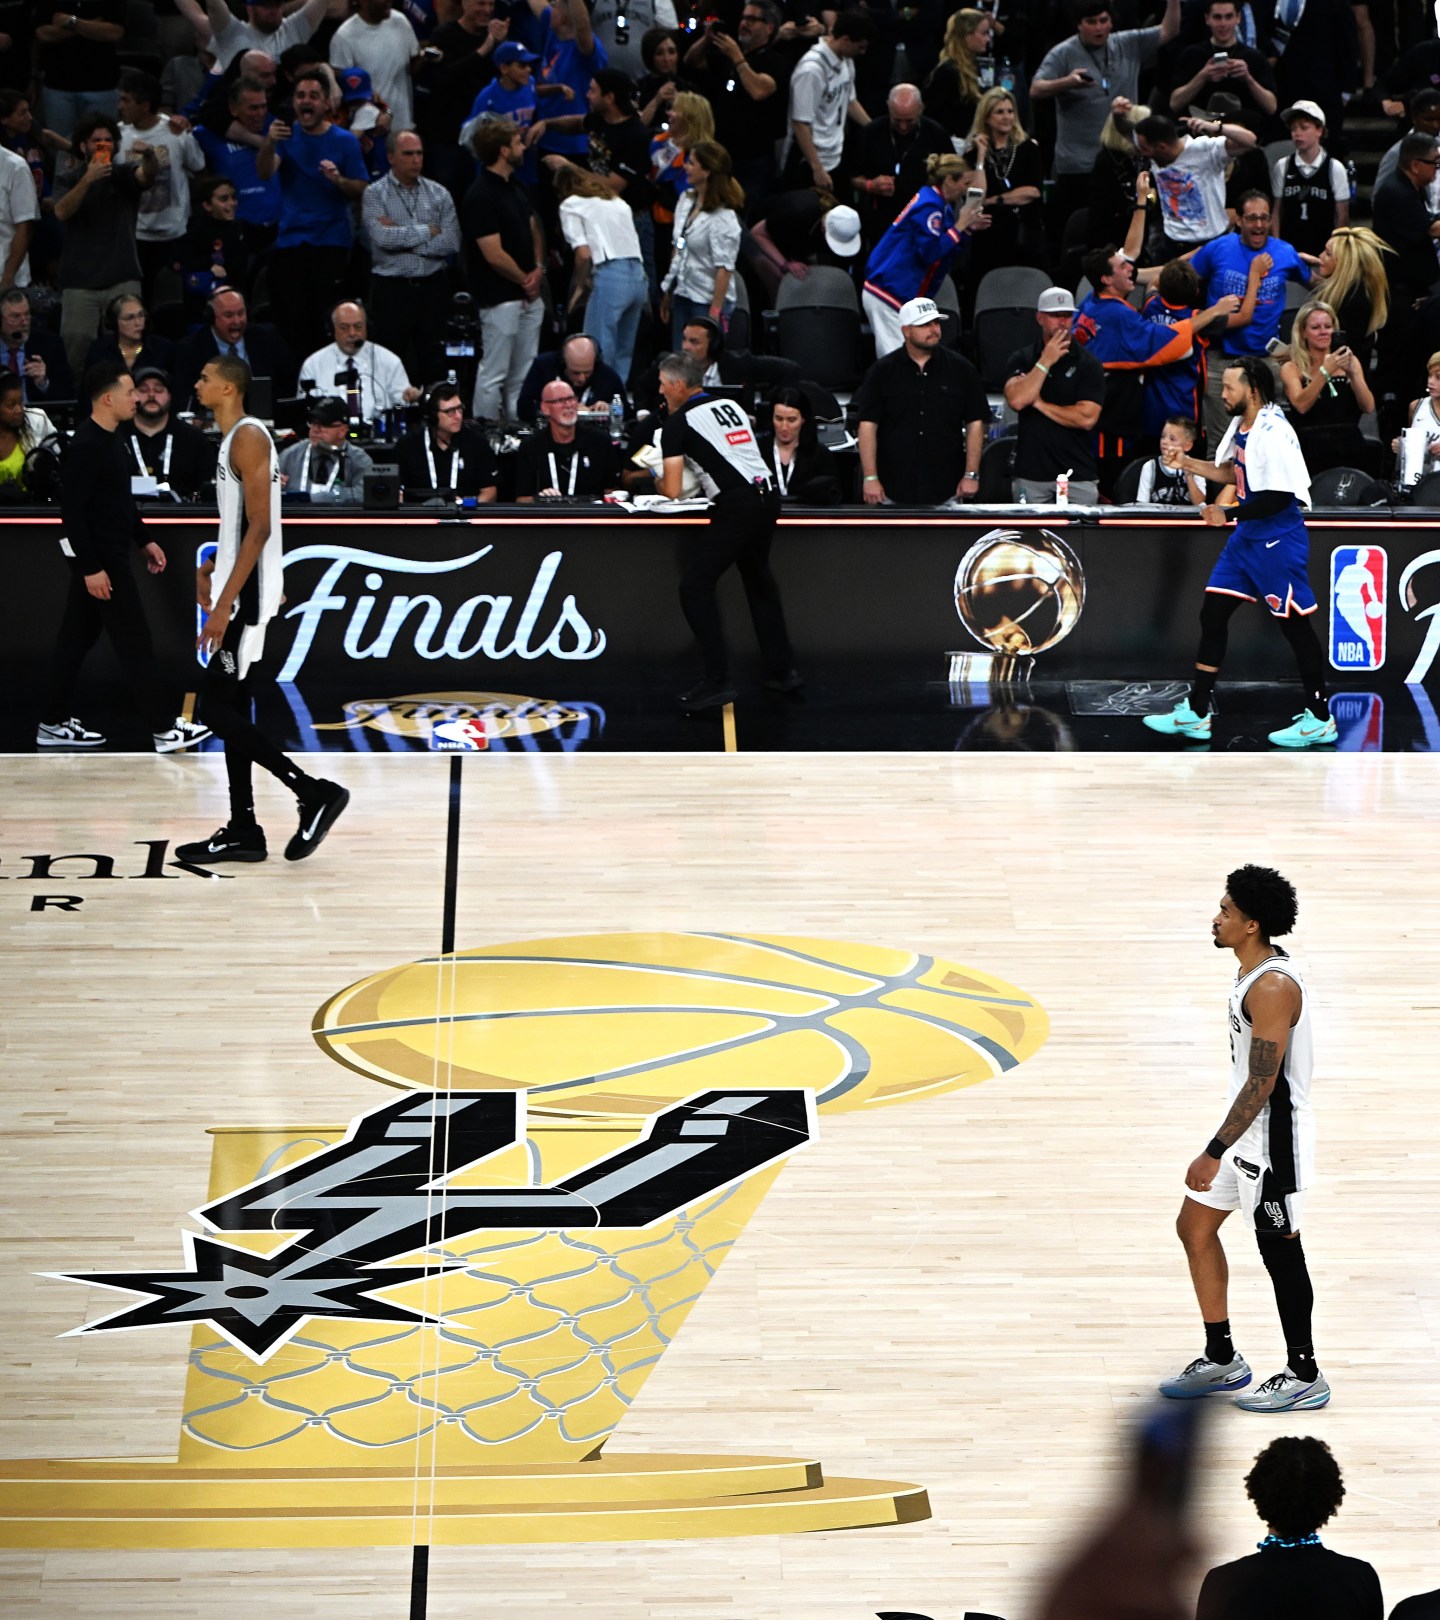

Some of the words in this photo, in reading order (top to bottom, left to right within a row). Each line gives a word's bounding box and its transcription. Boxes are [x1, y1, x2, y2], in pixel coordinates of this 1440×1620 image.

[710, 404, 743, 428] 48
[276, 544, 607, 682] Finals
[1338, 642, 1364, 662] NBA
[30, 895, 84, 911] R
